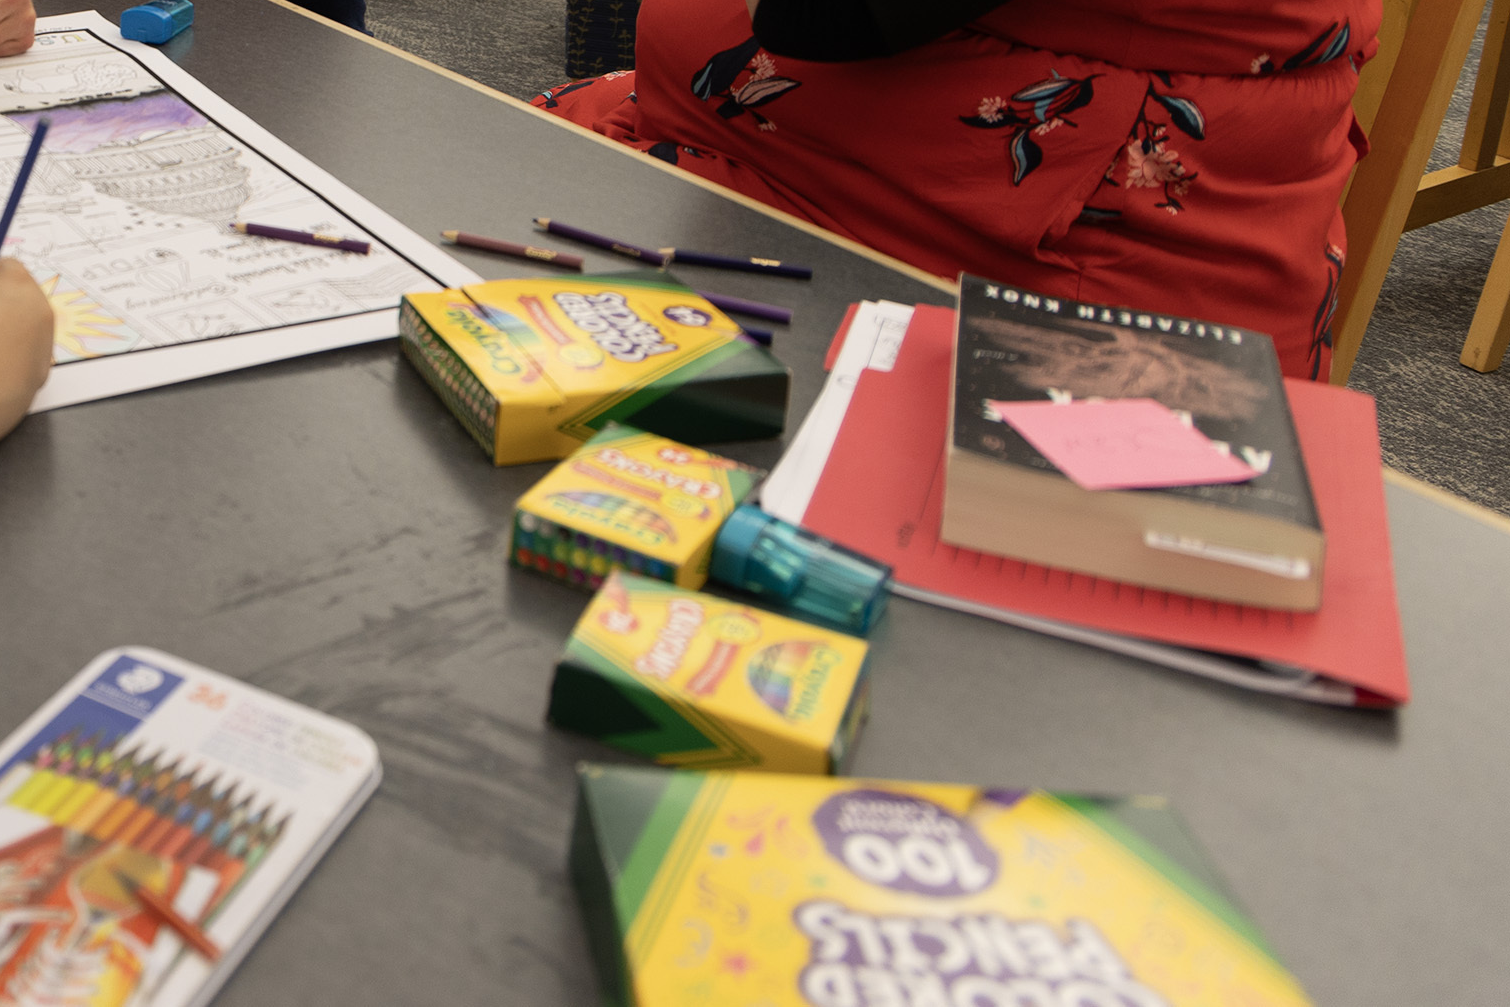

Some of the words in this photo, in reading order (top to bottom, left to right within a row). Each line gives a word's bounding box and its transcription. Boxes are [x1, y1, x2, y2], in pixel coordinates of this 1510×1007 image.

[554, 293, 645, 362] COLORED
[589, 292, 678, 355] PENCILS
[986, 285, 1060, 313] KNOX
[1077, 305, 1242, 345] ELIZABETH
[445, 308, 521, 375] Crayola
[595, 448, 721, 500] CRAYONS
[842, 830, 989, 891] 100
[796, 900, 1131, 981] PENCILS
